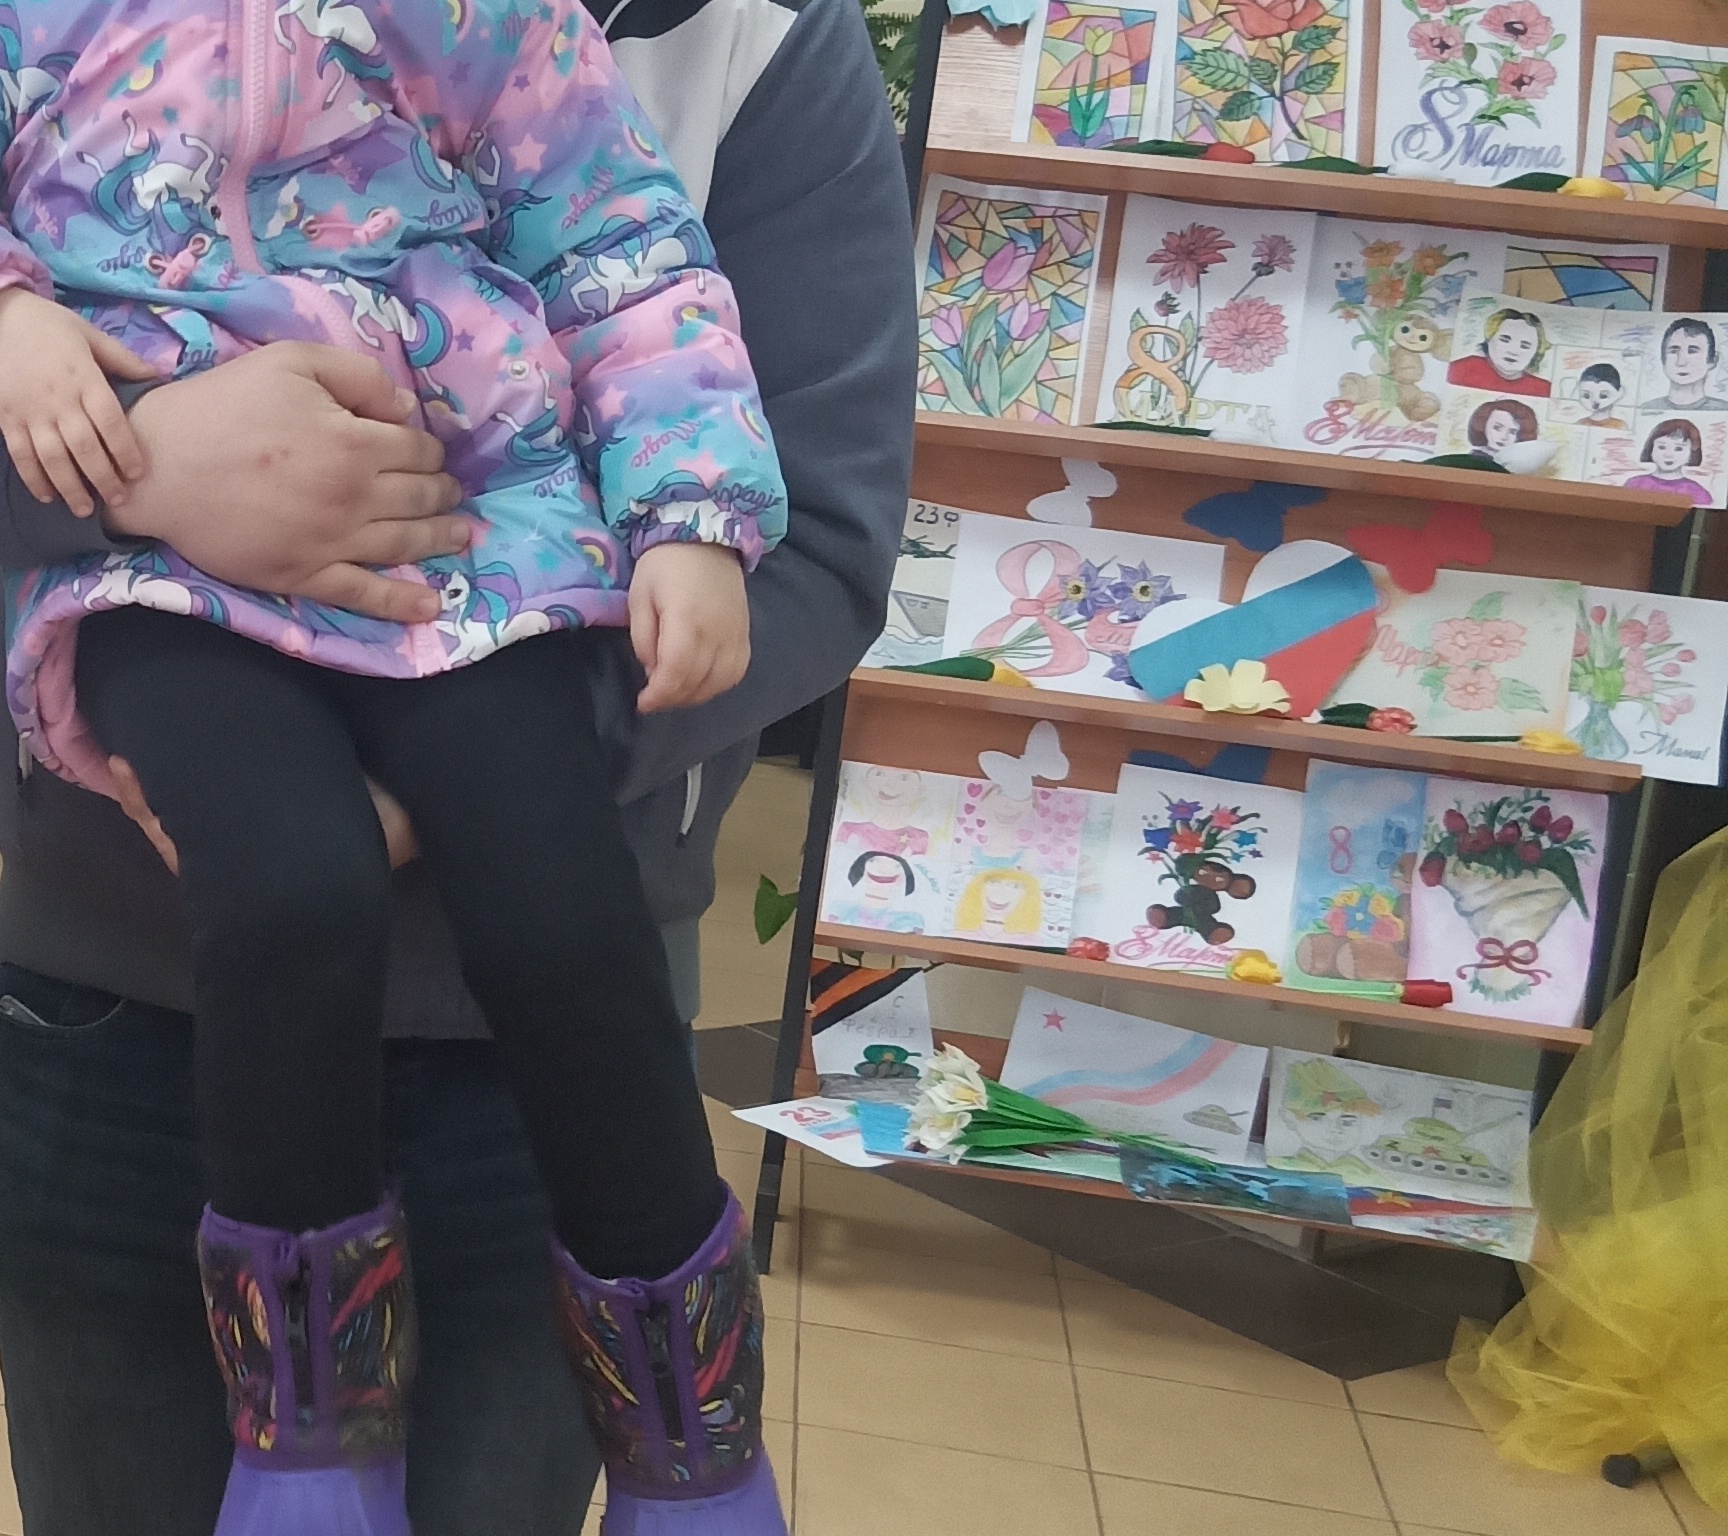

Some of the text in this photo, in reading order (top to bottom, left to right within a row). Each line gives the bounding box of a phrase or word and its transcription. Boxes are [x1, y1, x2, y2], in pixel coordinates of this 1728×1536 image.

[1439, 121, 1566, 181] Марта
[96, 243, 148, 276] agic
[1113, 325, 1192, 421] 8
[631, 419, 702, 468] Magic
[1303, 399, 1439, 456] 8 Март
[533, 465, 580, 499] agic
[913, 503, 939, 525] 23
[1328, 825, 1353, 875] 8
[1114, 924, 1234, 968] 8 Март
